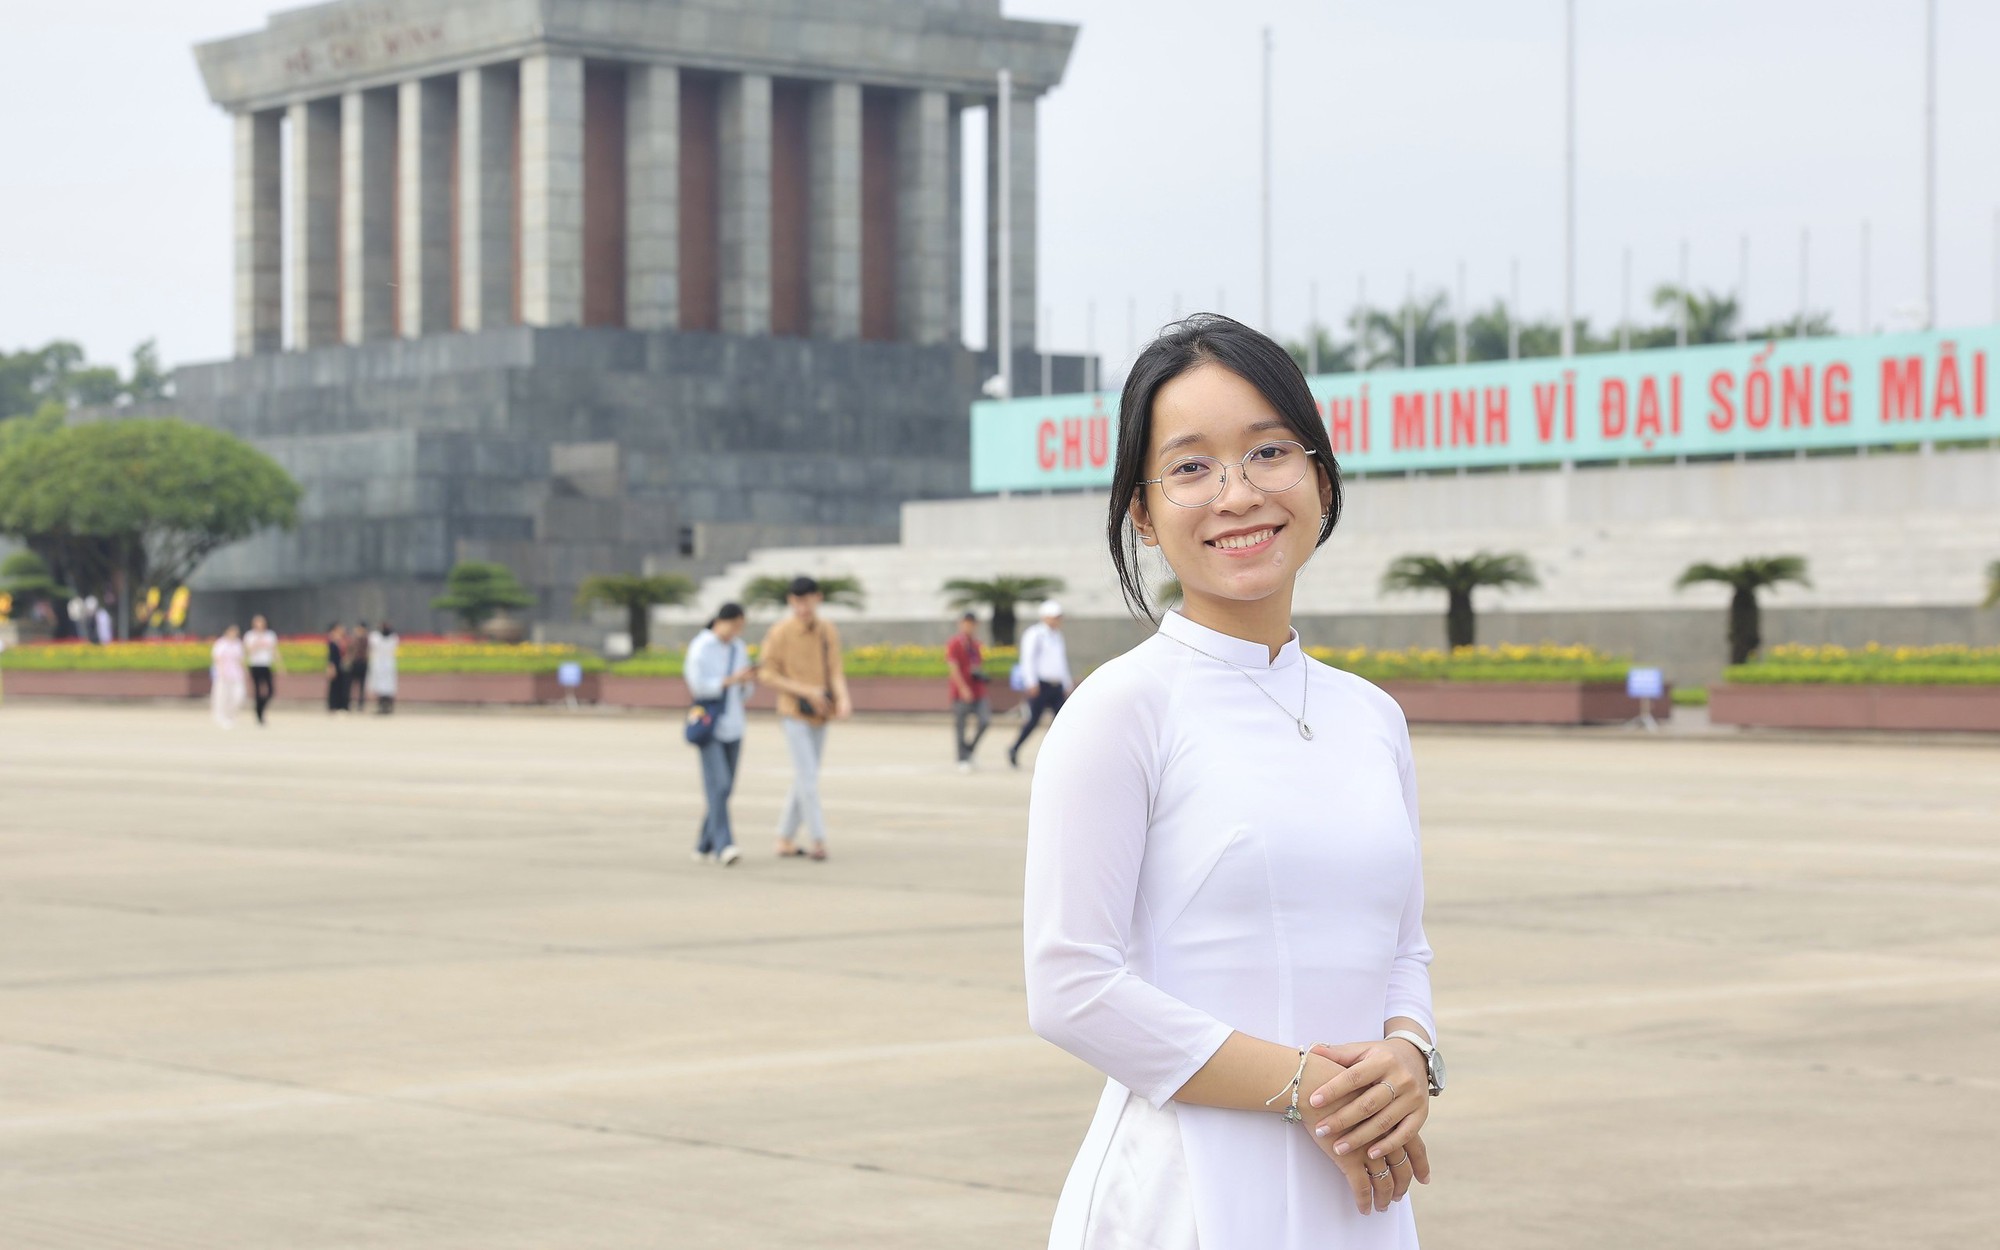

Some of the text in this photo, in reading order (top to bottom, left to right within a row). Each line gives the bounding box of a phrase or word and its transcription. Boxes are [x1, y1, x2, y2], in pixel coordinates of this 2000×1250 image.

[1315, 383, 1371, 454] HÍ
[1391, 384, 1510, 452] MINH
[1600, 373, 1684, 450] ĐẠI
[1706, 341, 1854, 434] SỐNG
[1879, 340, 1987, 423] MÃI
